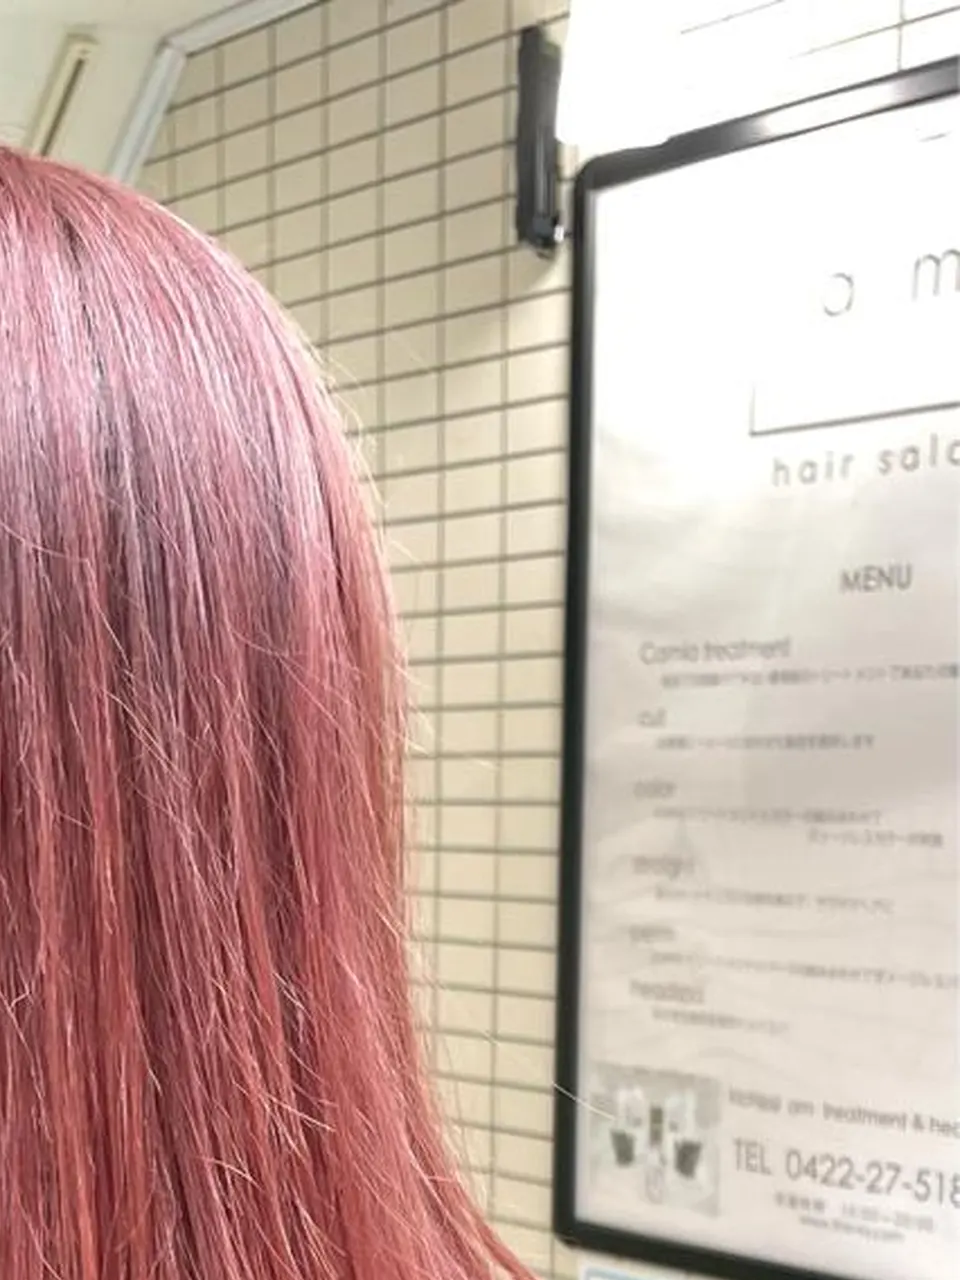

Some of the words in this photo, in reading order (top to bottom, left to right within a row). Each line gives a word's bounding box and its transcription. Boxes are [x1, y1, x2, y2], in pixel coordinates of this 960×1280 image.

[772, 450, 854, 487] hair
[839, 563, 912, 594] MENU
[823, 1101, 907, 1132] treatment
[734, 1138, 772, 1175] TEL
